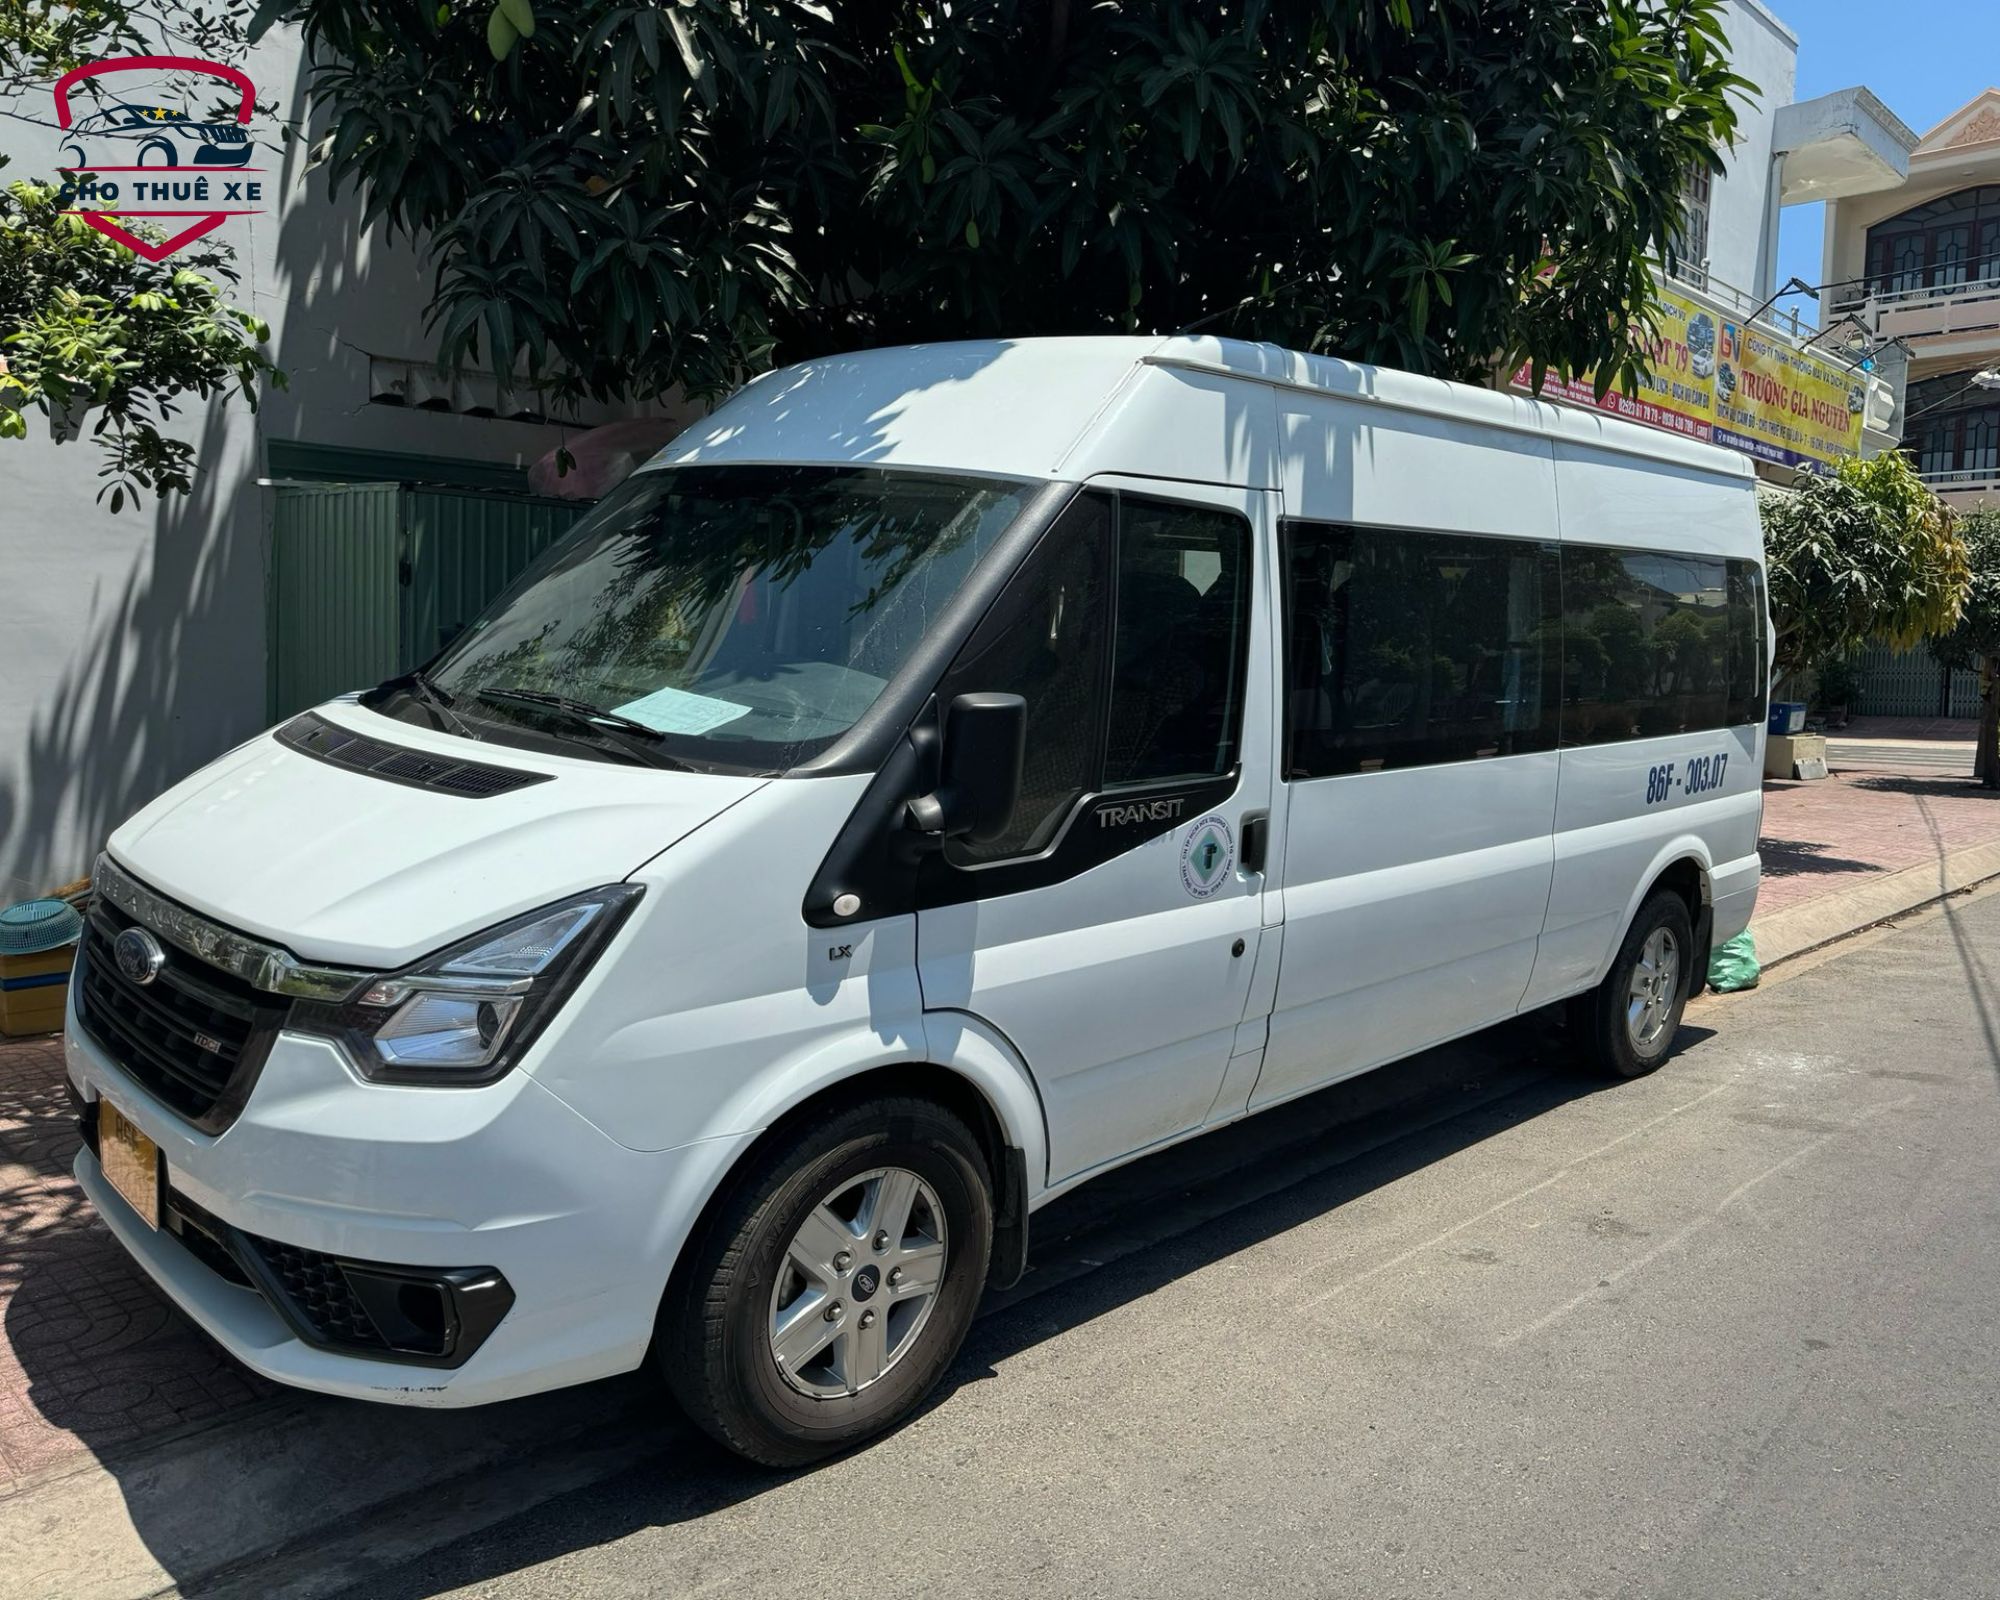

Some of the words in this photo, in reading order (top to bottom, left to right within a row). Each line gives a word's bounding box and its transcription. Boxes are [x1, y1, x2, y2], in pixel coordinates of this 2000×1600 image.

[1675, 342, 1688, 372] 79
[1740, 369, 1787, 410] TRƯỜNG
[1791, 390, 1808, 418] GIA
[1811, 398, 1851, 432] NGUYÊN
[1646, 763, 1674, 804] 86F
[1096, 798, 1184, 828] TRANSIT
[829, 944, 852, 960] LX
